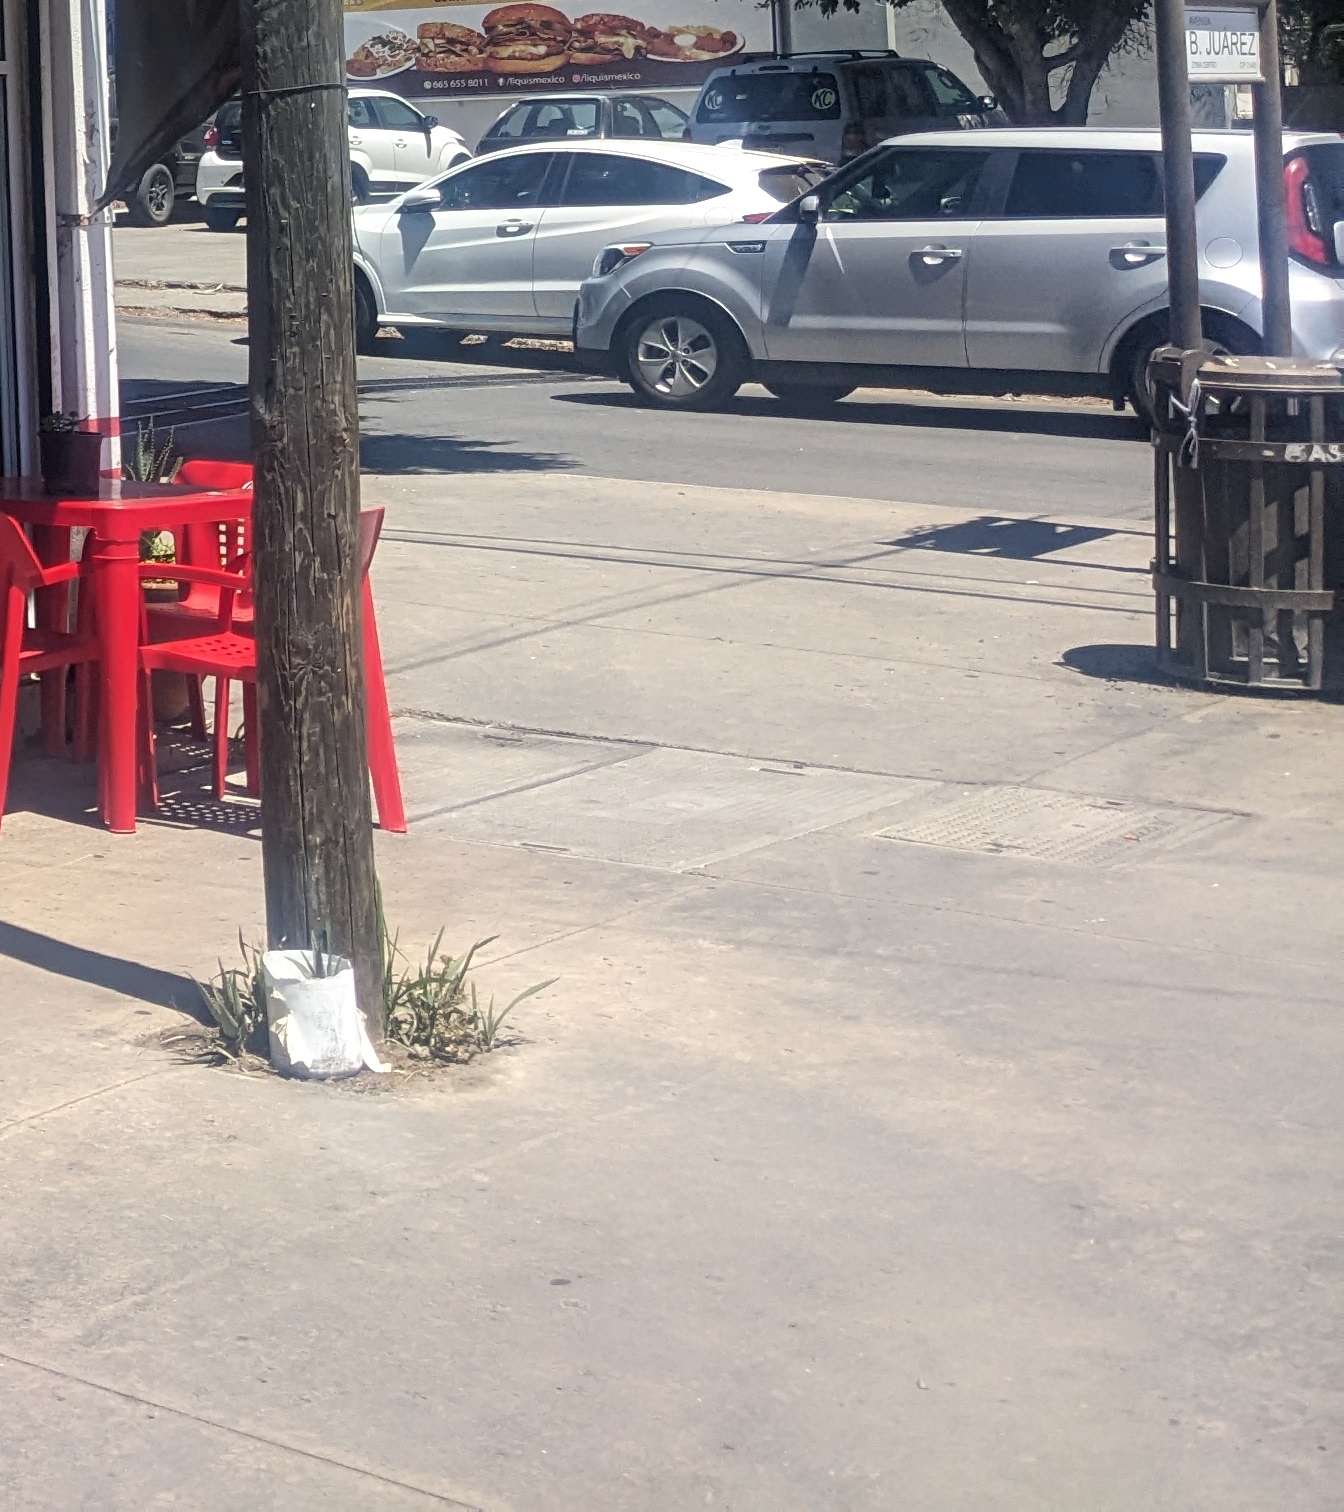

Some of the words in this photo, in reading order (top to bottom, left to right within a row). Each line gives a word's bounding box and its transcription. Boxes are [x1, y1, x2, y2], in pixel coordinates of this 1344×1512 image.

[1189, 31, 1202, 56] B.
[1206, 26, 1257, 56] JUÁREZ
[813, 89, 834, 108] KC
